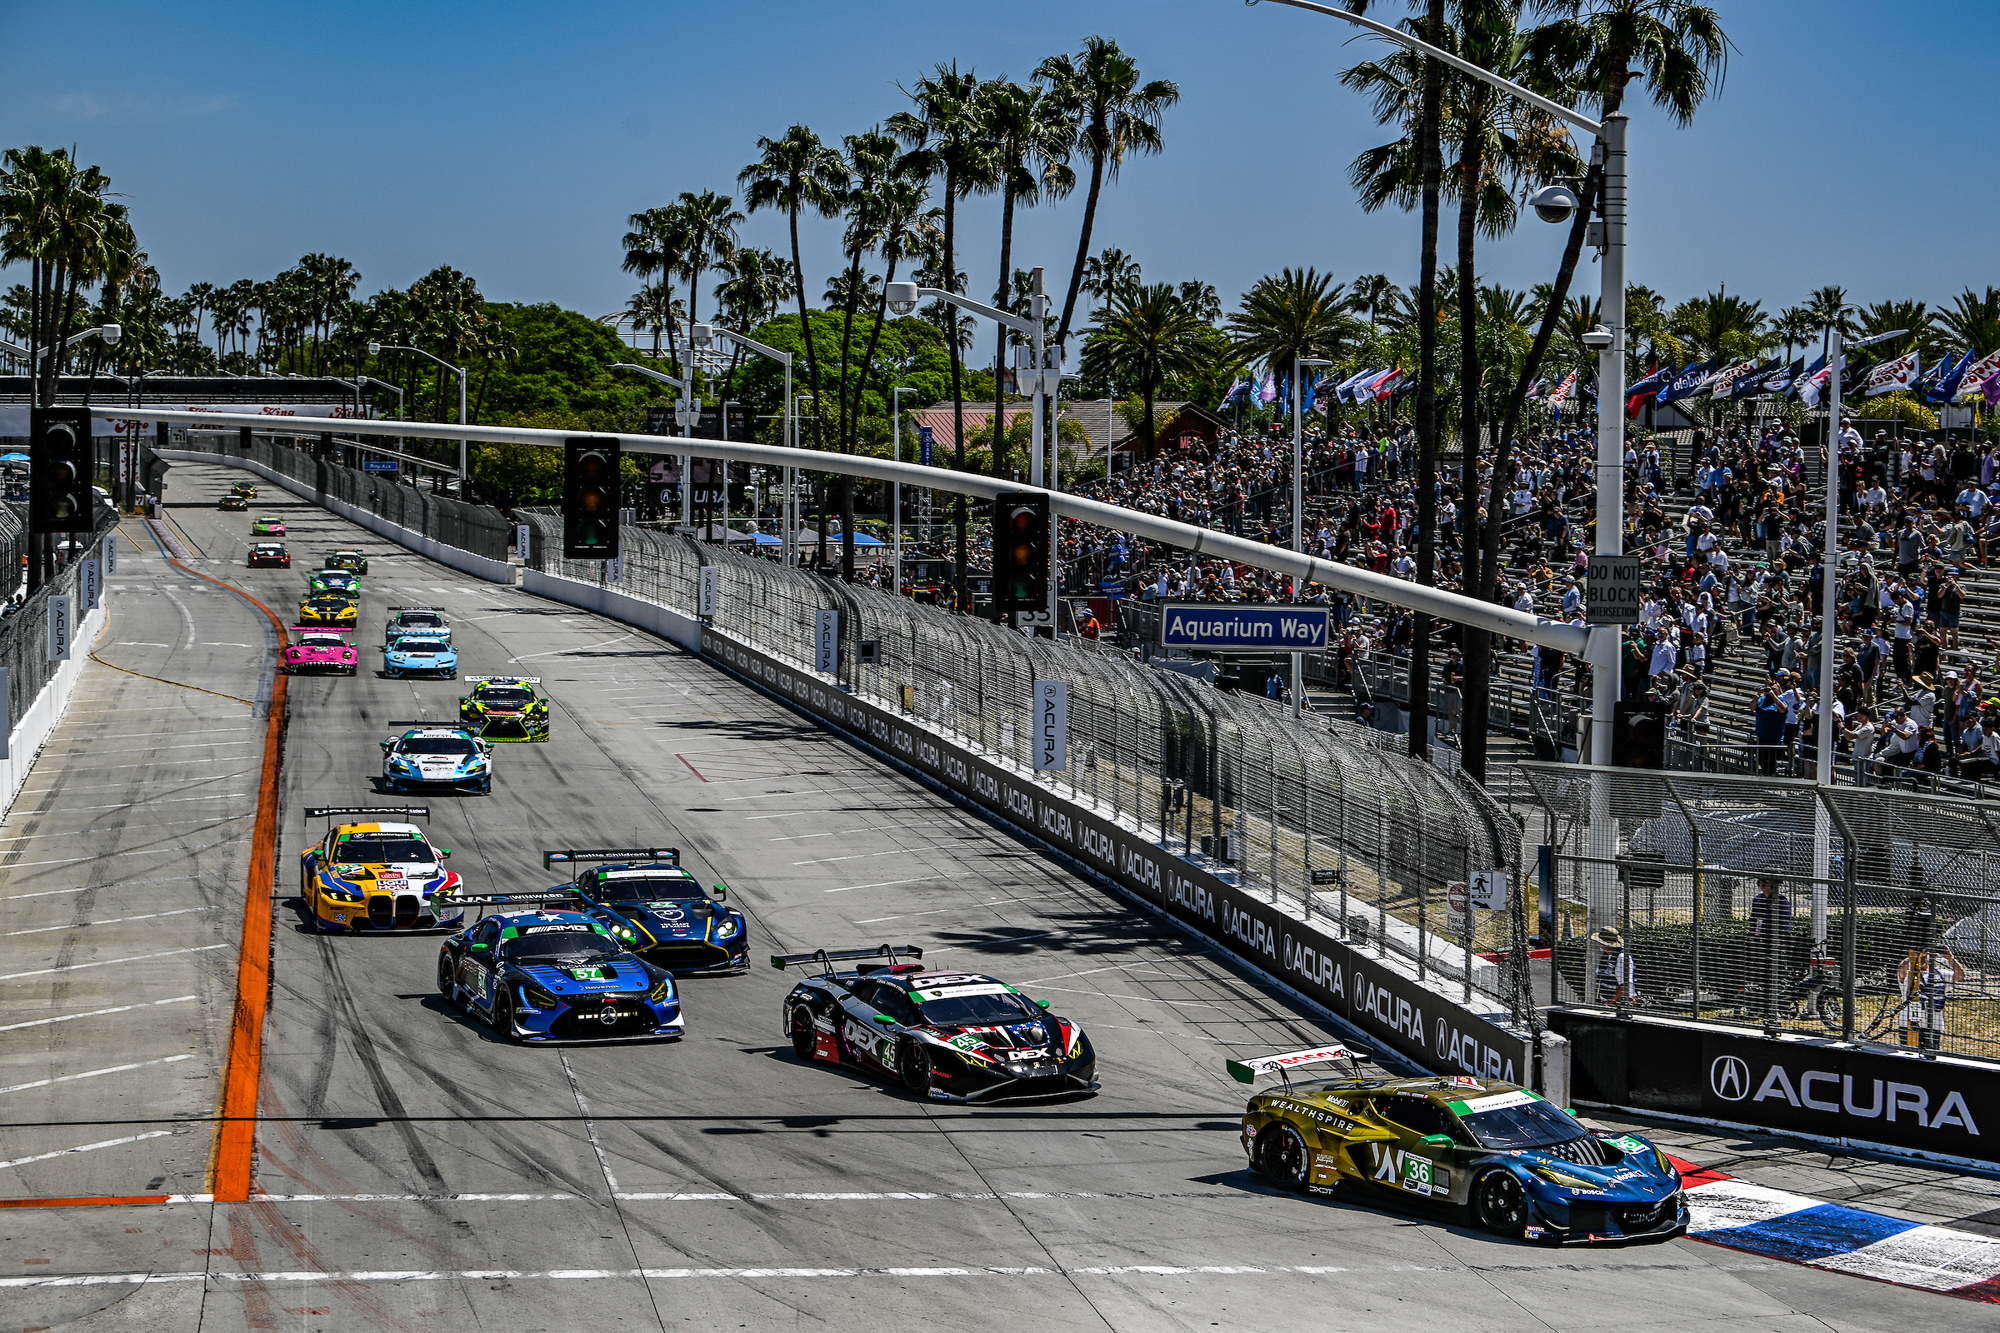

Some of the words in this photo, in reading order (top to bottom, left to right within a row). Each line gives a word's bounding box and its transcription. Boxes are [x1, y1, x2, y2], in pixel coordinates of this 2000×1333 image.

[1590, 565, 1608, 580] DO
[1614, 565, 1638, 580] NOT
[1590, 587, 1636, 602] BLOCK
[1588, 606, 1636, 618] INTERSECTION
[56, 610, 65, 656] ACURA
[1169, 615, 1273, 641] Aquarium
[1280, 618, 1324, 644] Way
[822, 622, 832, 670] ACURA
[850, 706, 866, 732] ACURA
[872, 717, 889, 743] ACURA
[1044, 698, 1055, 766] ACURA
[894, 728, 913, 756] ACURA
[920, 740, 940, 770] ACURA
[946, 758, 968, 786] ACURA
[975, 772, 999, 804] ACURA
[1006, 788, 1034, 822] ACURA
[1043, 808, 1072, 843] ACURA
[1084, 827, 1116, 866] ACURA
[1126, 850, 1162, 893] ACURA
[1174, 876, 1215, 923] ACURA
[1230, 908, 1276, 959] ACURA
[576, 969, 597, 978] 57
[910, 975, 989, 989] DEX
[1293, 942, 1344, 999] ACURA
[1364, 982, 1426, 1046] ACURA
[845, 1020, 880, 1056] DEX
[884, 1042, 896, 1062] 45
[957, 1035, 977, 1048] 45
[1008, 1047, 1051, 1060] DEX
[1448, 1028, 1515, 1084] ACURA
[932, 1068, 952, 1078] SHARP
[1326, 1094, 1341, 1106] Mobil
[1474, 1096, 1530, 1109] CORVETTE
[1752, 1065, 1980, 1135] ACURA
[1270, 1100, 1353, 1132] WEALTHSPIRE
[1410, 1160, 1429, 1182] 36
